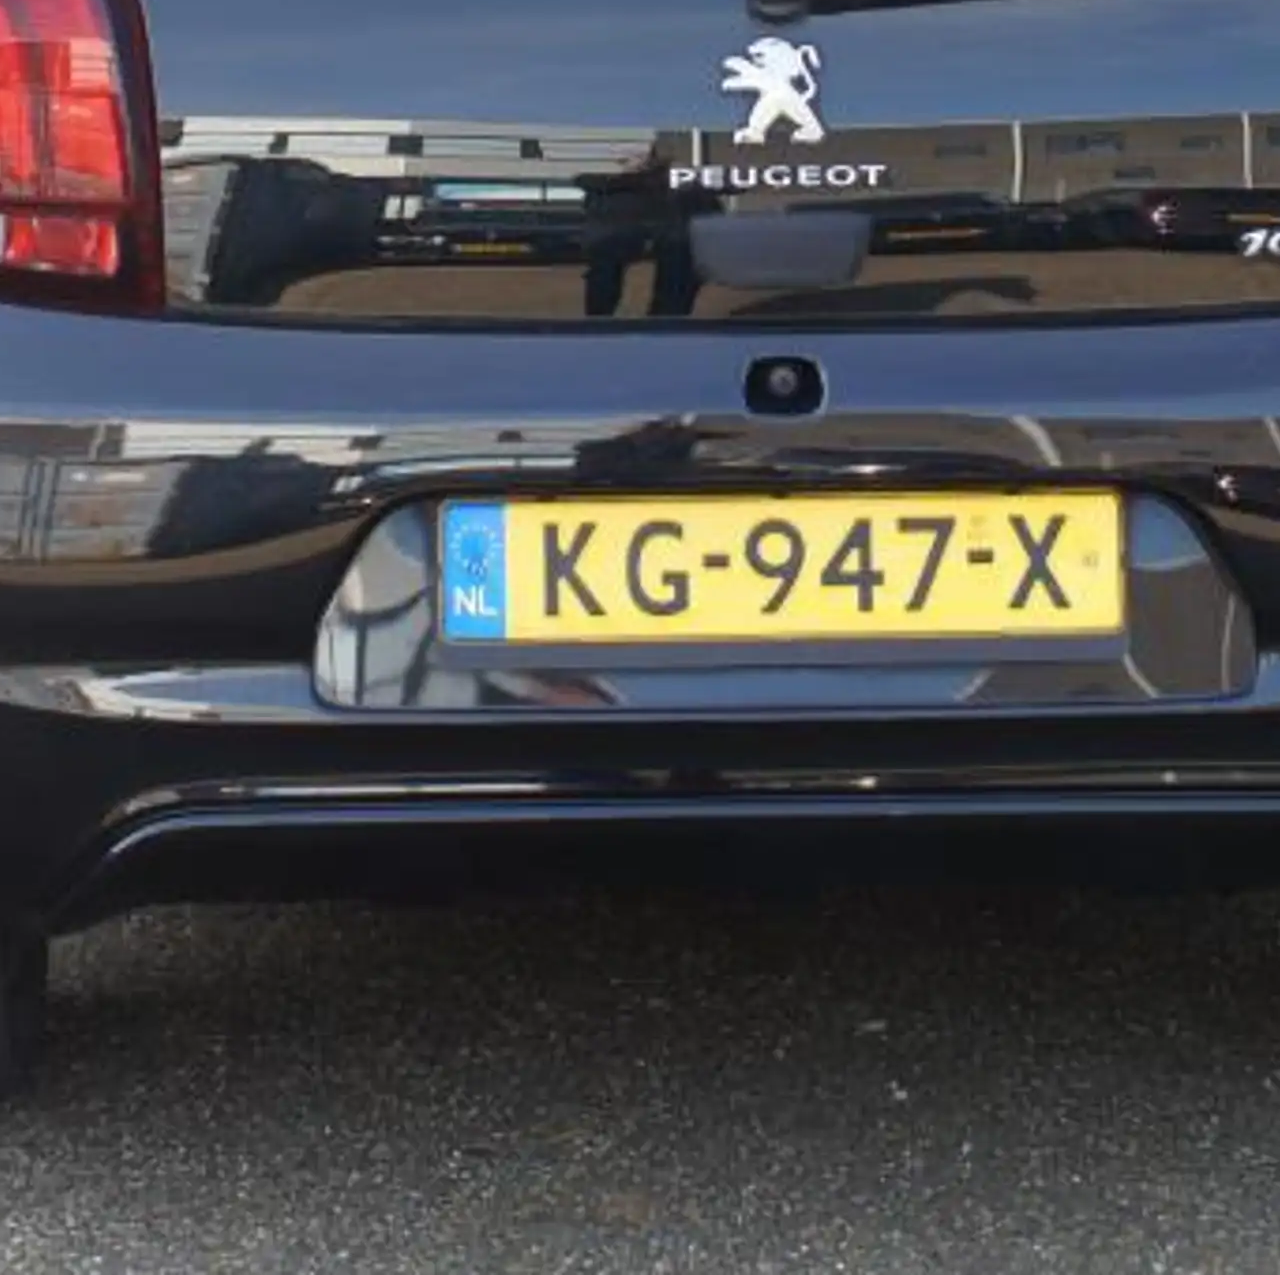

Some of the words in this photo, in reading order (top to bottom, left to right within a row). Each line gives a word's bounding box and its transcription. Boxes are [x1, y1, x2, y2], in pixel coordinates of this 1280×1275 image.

[668, 164, 886, 189] PEUGEOT
[452, 587, 497, 618] NL
[541, 514, 1073, 617] KG-947-X
